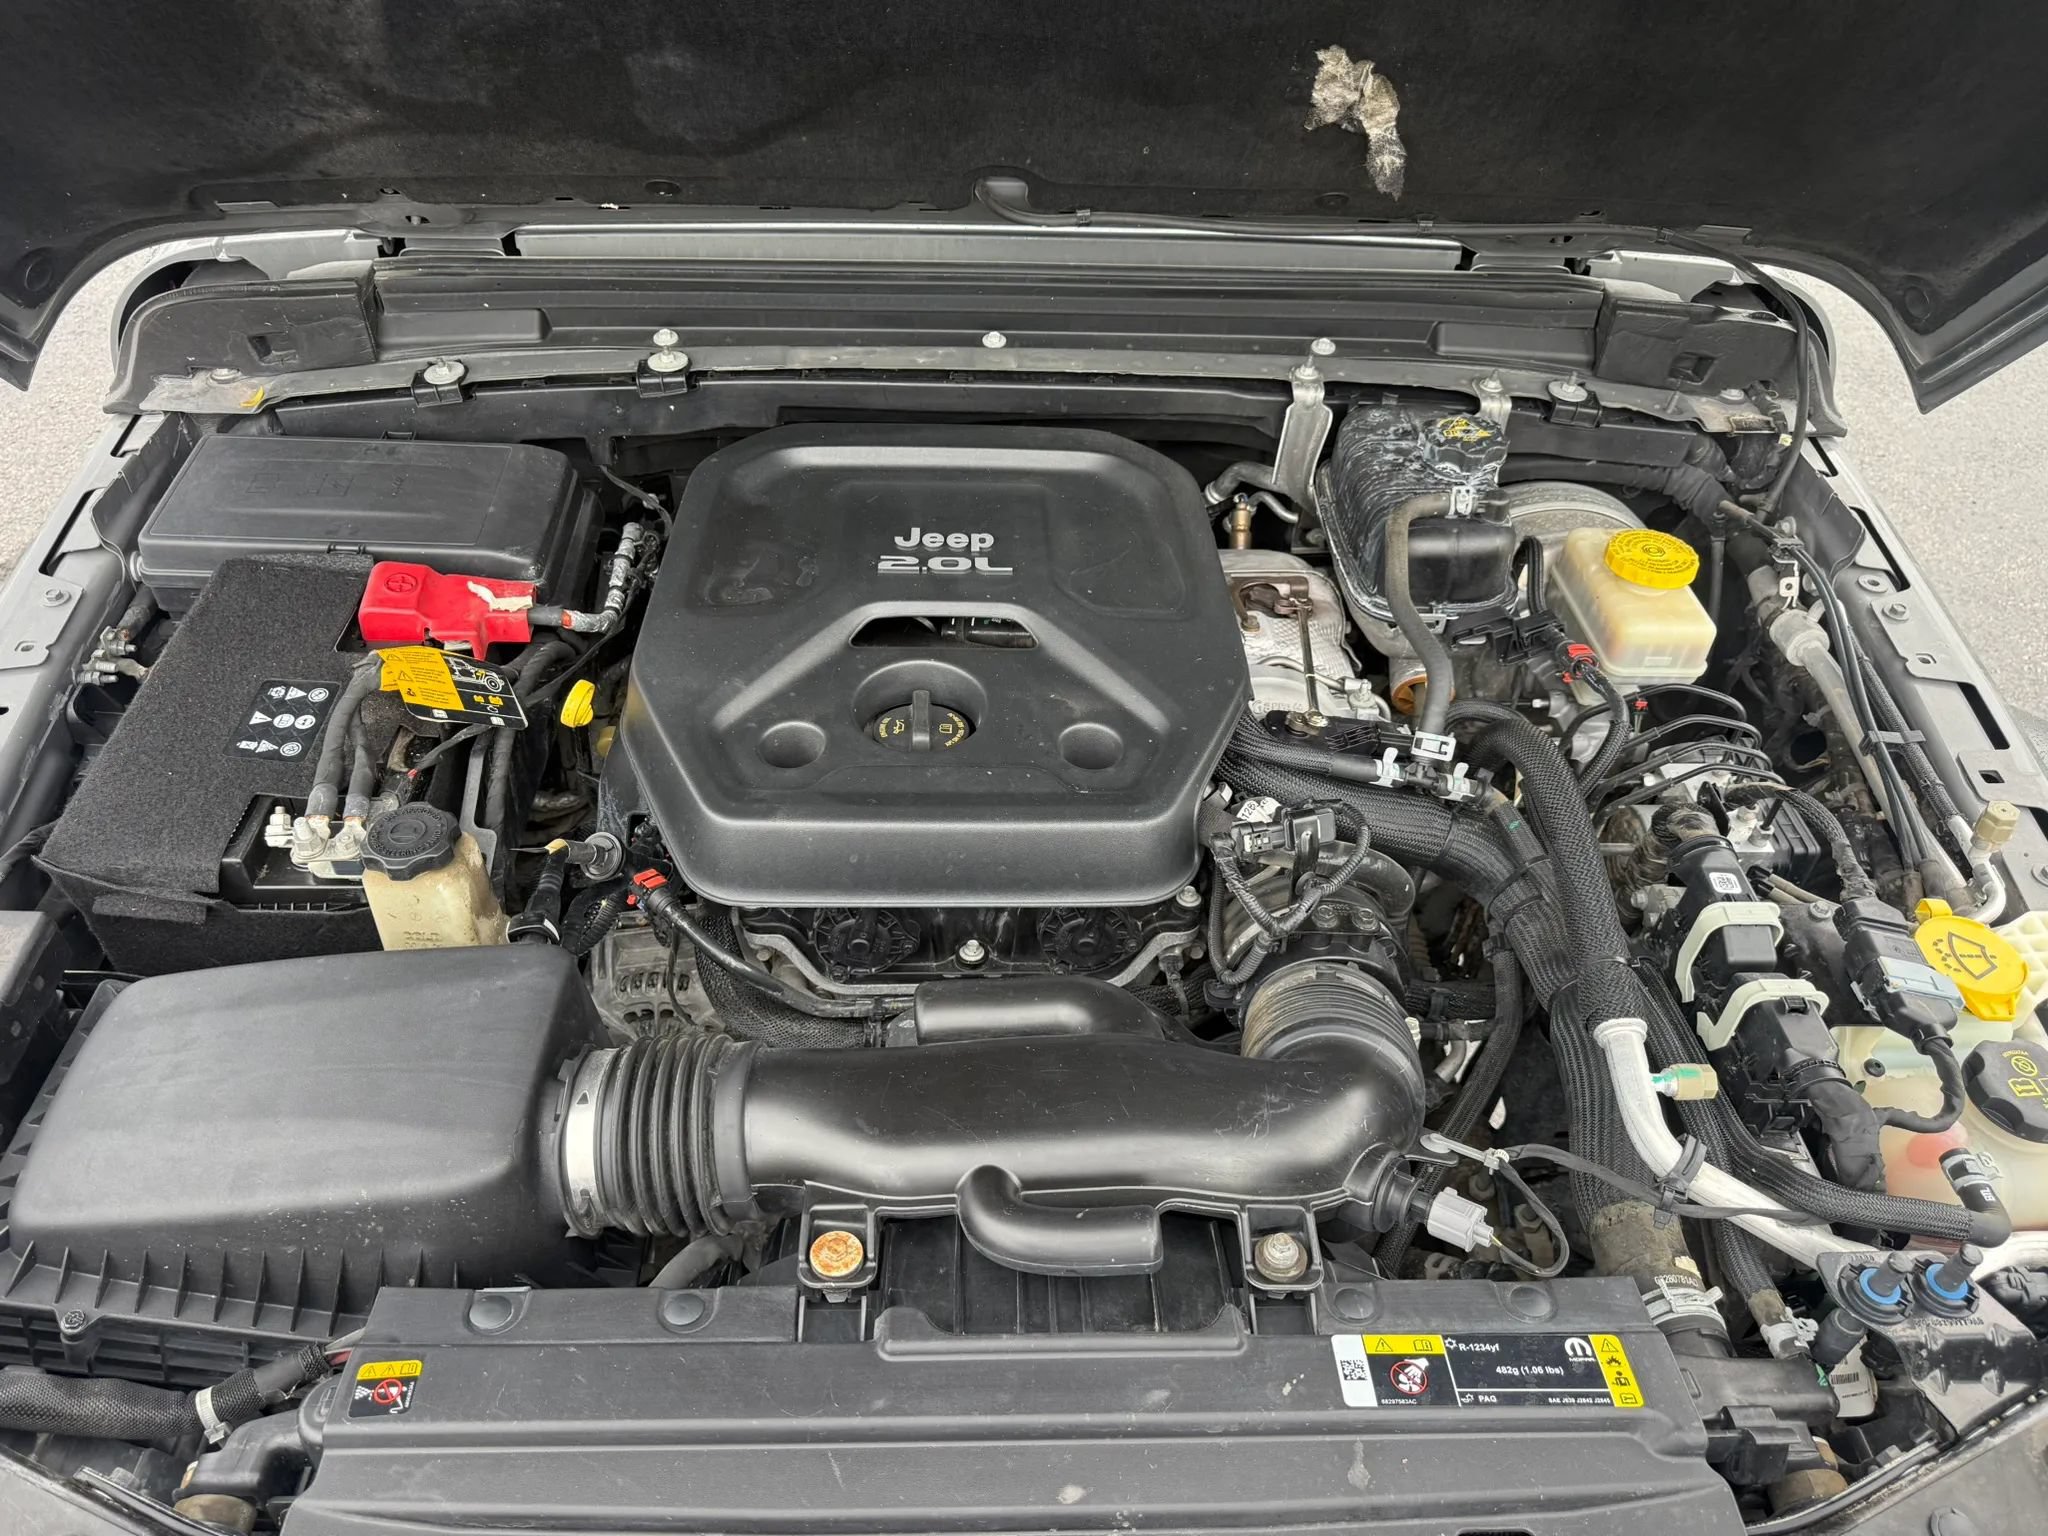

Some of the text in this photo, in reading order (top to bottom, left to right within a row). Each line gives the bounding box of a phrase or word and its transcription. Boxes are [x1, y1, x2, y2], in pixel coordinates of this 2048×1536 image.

[894, 527, 995, 552] Jeep
[877, 555, 1014, 574] 2.0L
[1459, 1343, 1500, 1353] R-1234yf
[1496, 1366, 1564, 1376] 482g (1.06 lbs)
[1478, 1395, 1497, 1403] PAG
